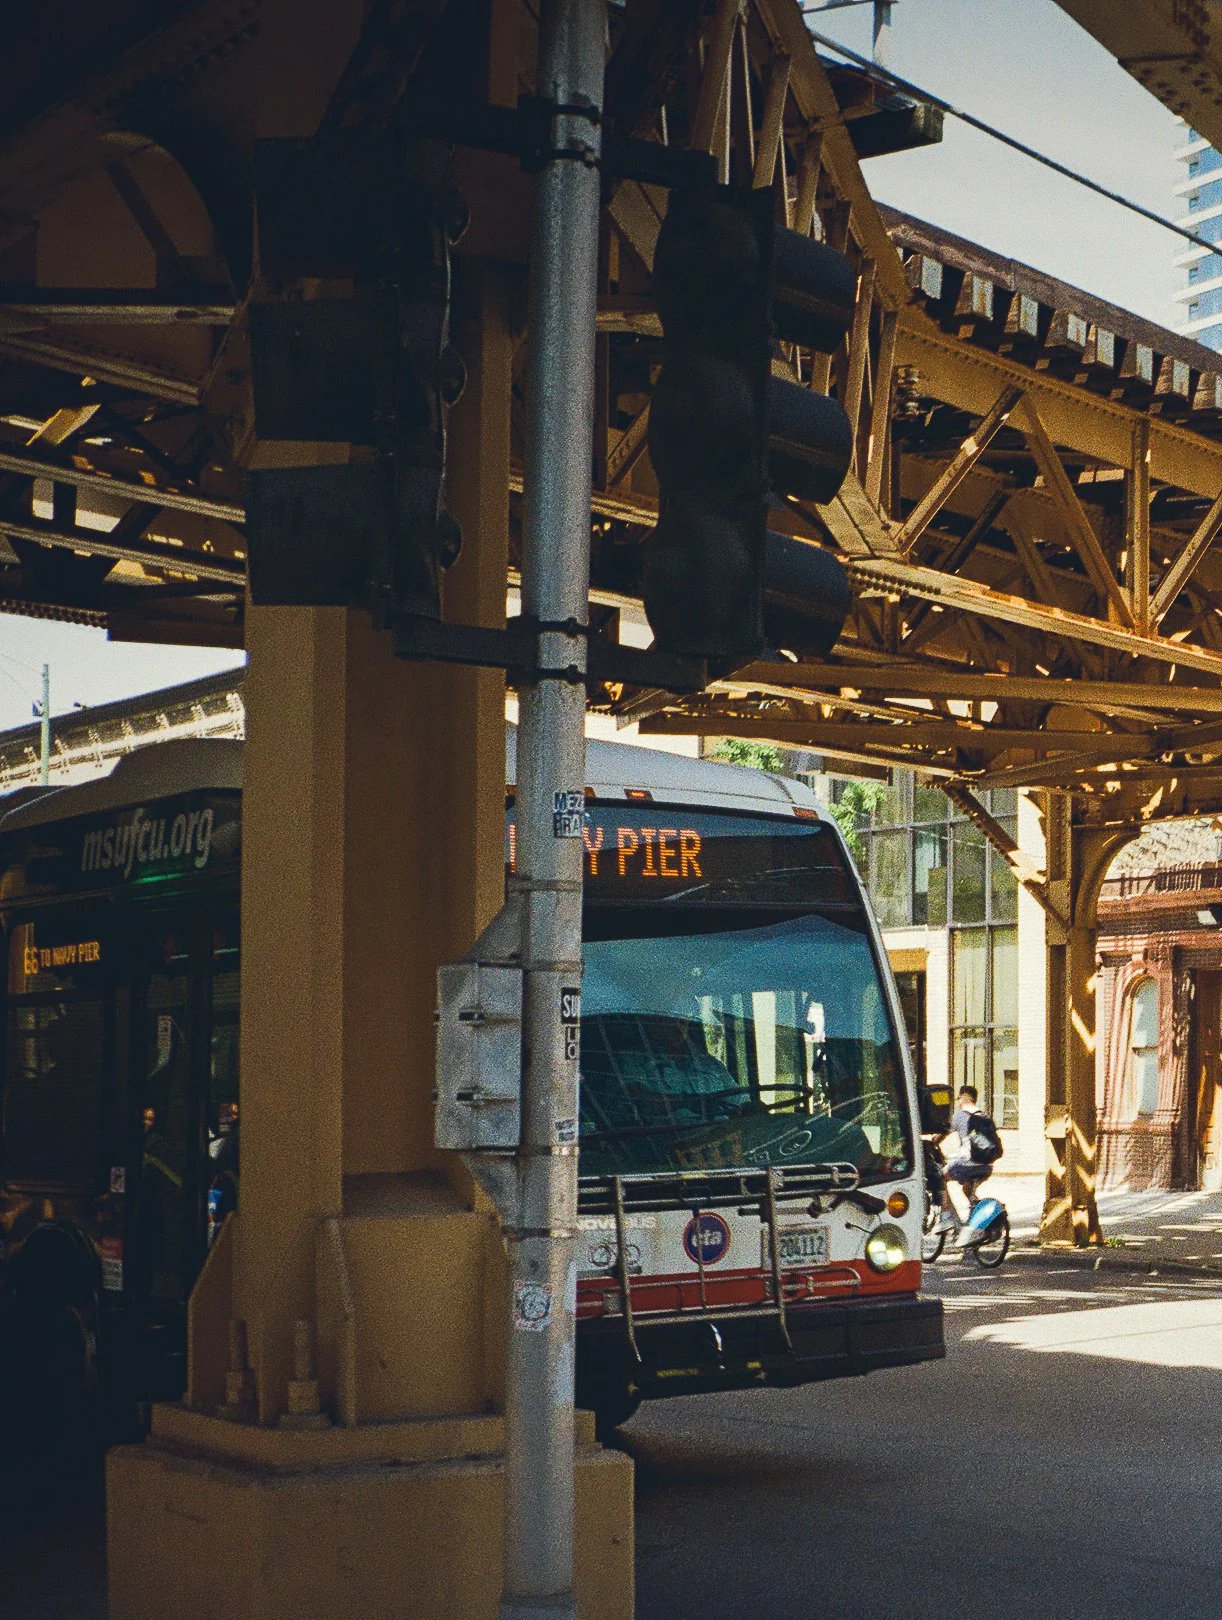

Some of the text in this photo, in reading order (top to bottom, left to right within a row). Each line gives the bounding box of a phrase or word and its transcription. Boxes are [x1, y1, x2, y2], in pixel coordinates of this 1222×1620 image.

[81, 807, 214, 879] msufcu.org
[617, 827, 703, 877] PIER
[24, 946, 38, 974] 66
[40, 948, 51, 968] TO
[78, 941, 100, 963] PIER
